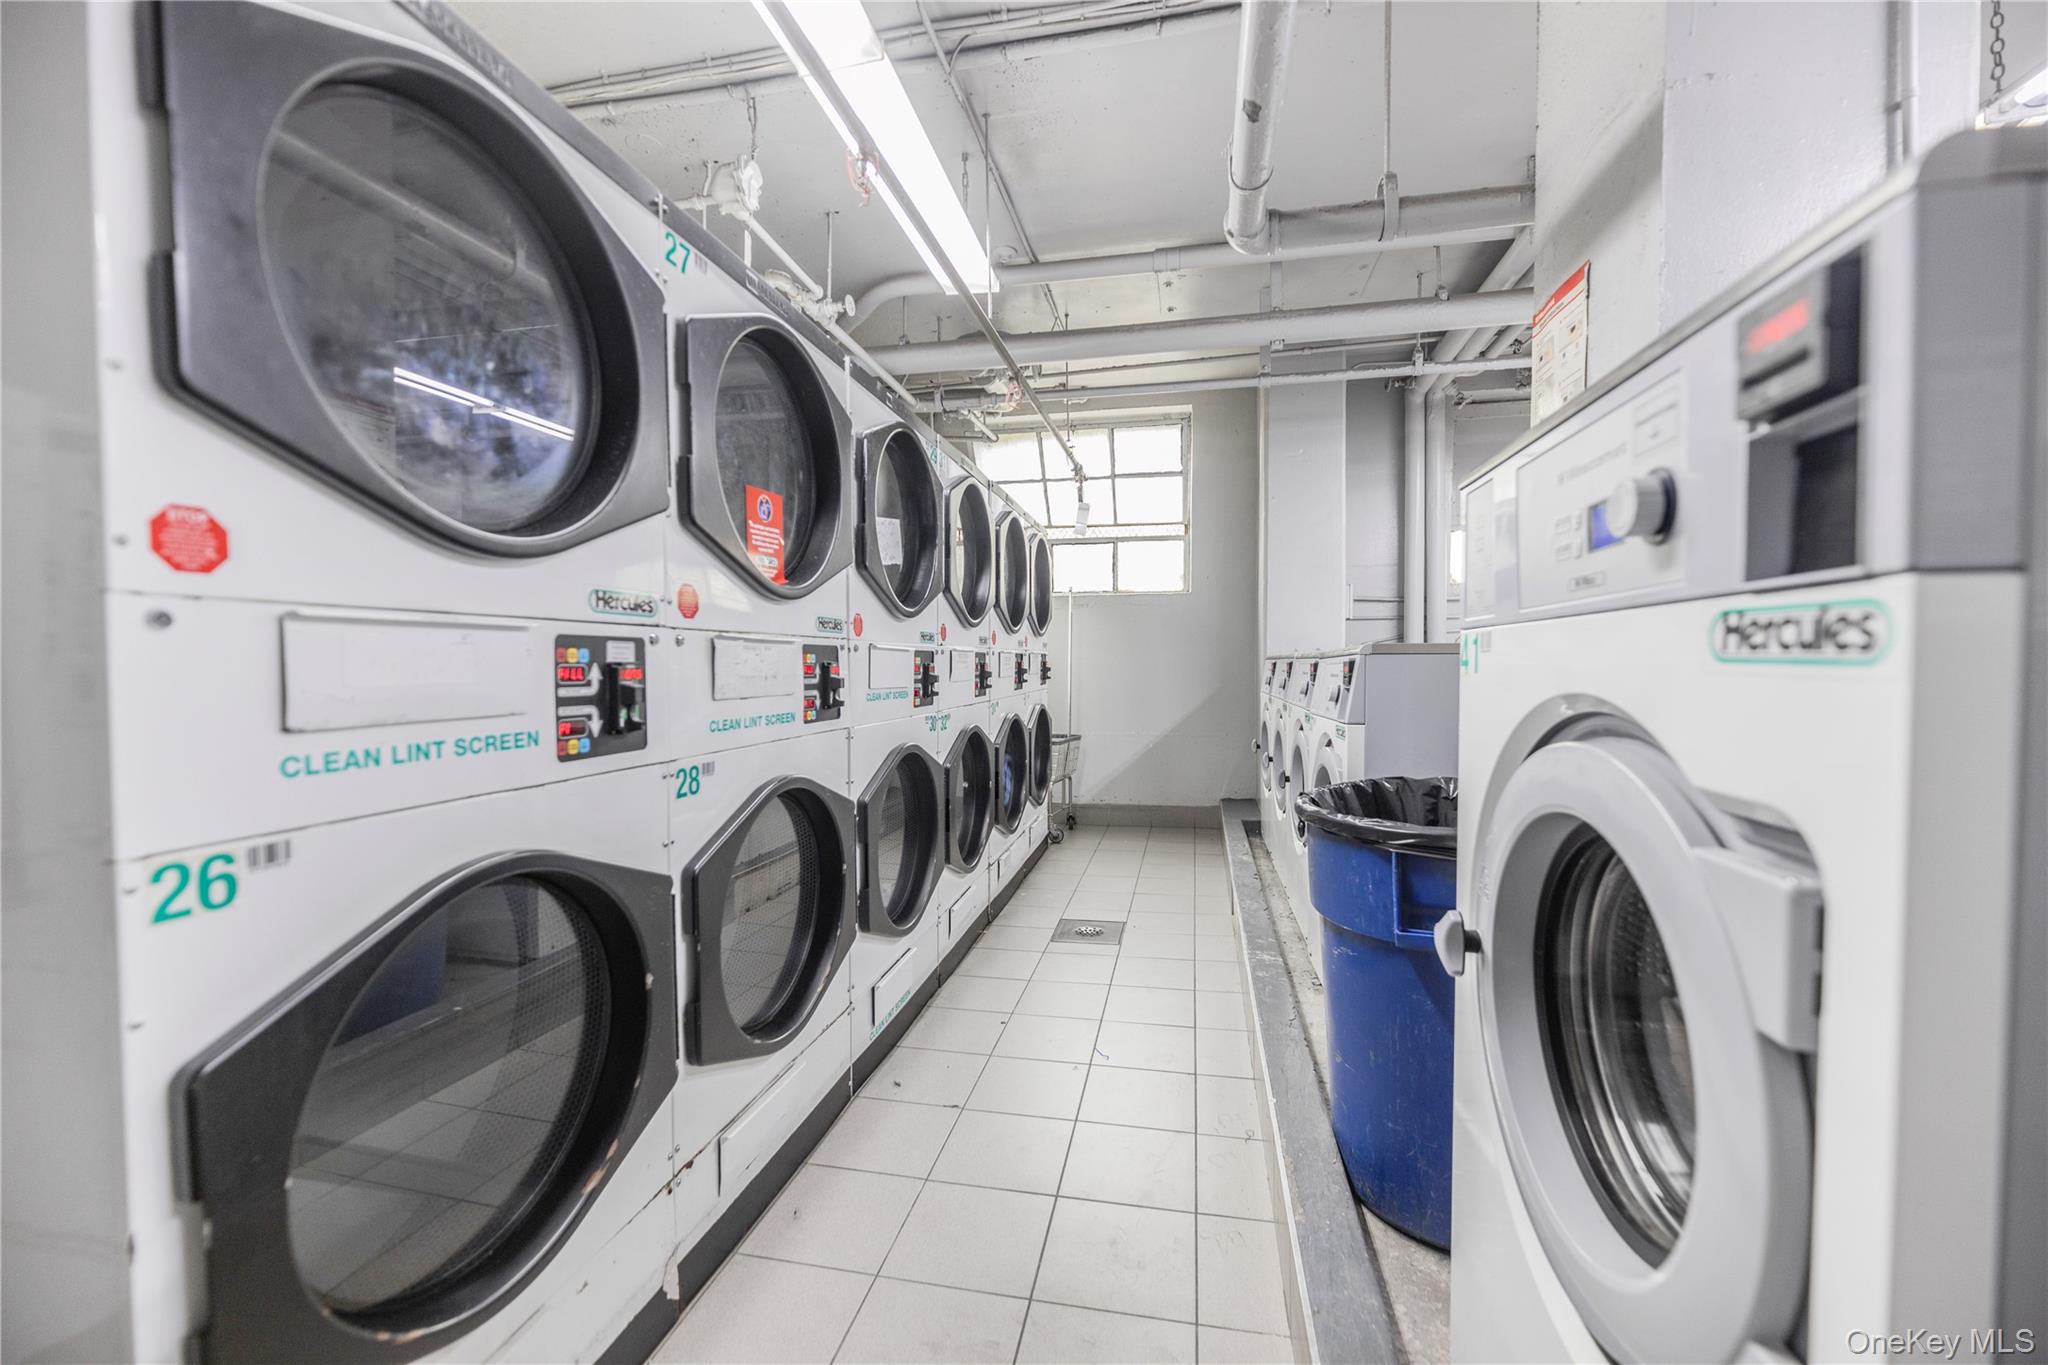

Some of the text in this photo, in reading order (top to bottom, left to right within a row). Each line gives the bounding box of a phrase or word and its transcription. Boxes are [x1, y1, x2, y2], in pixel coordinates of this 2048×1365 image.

[665, 231, 691, 273] 27
[594, 588, 655, 614] Hercules
[818, 616, 843, 632] Hercules
[1721, 604, 1875, 651] Hercules
[865, 690, 909, 702] CLEAN LINT SCREEN
[709, 712, 796, 733] CLEAN LINT SCREEN
[280, 730, 540, 779] CLEAN LINT SCREEN
[675, 765, 700, 799] 28
[150, 853, 237, 924] 26
